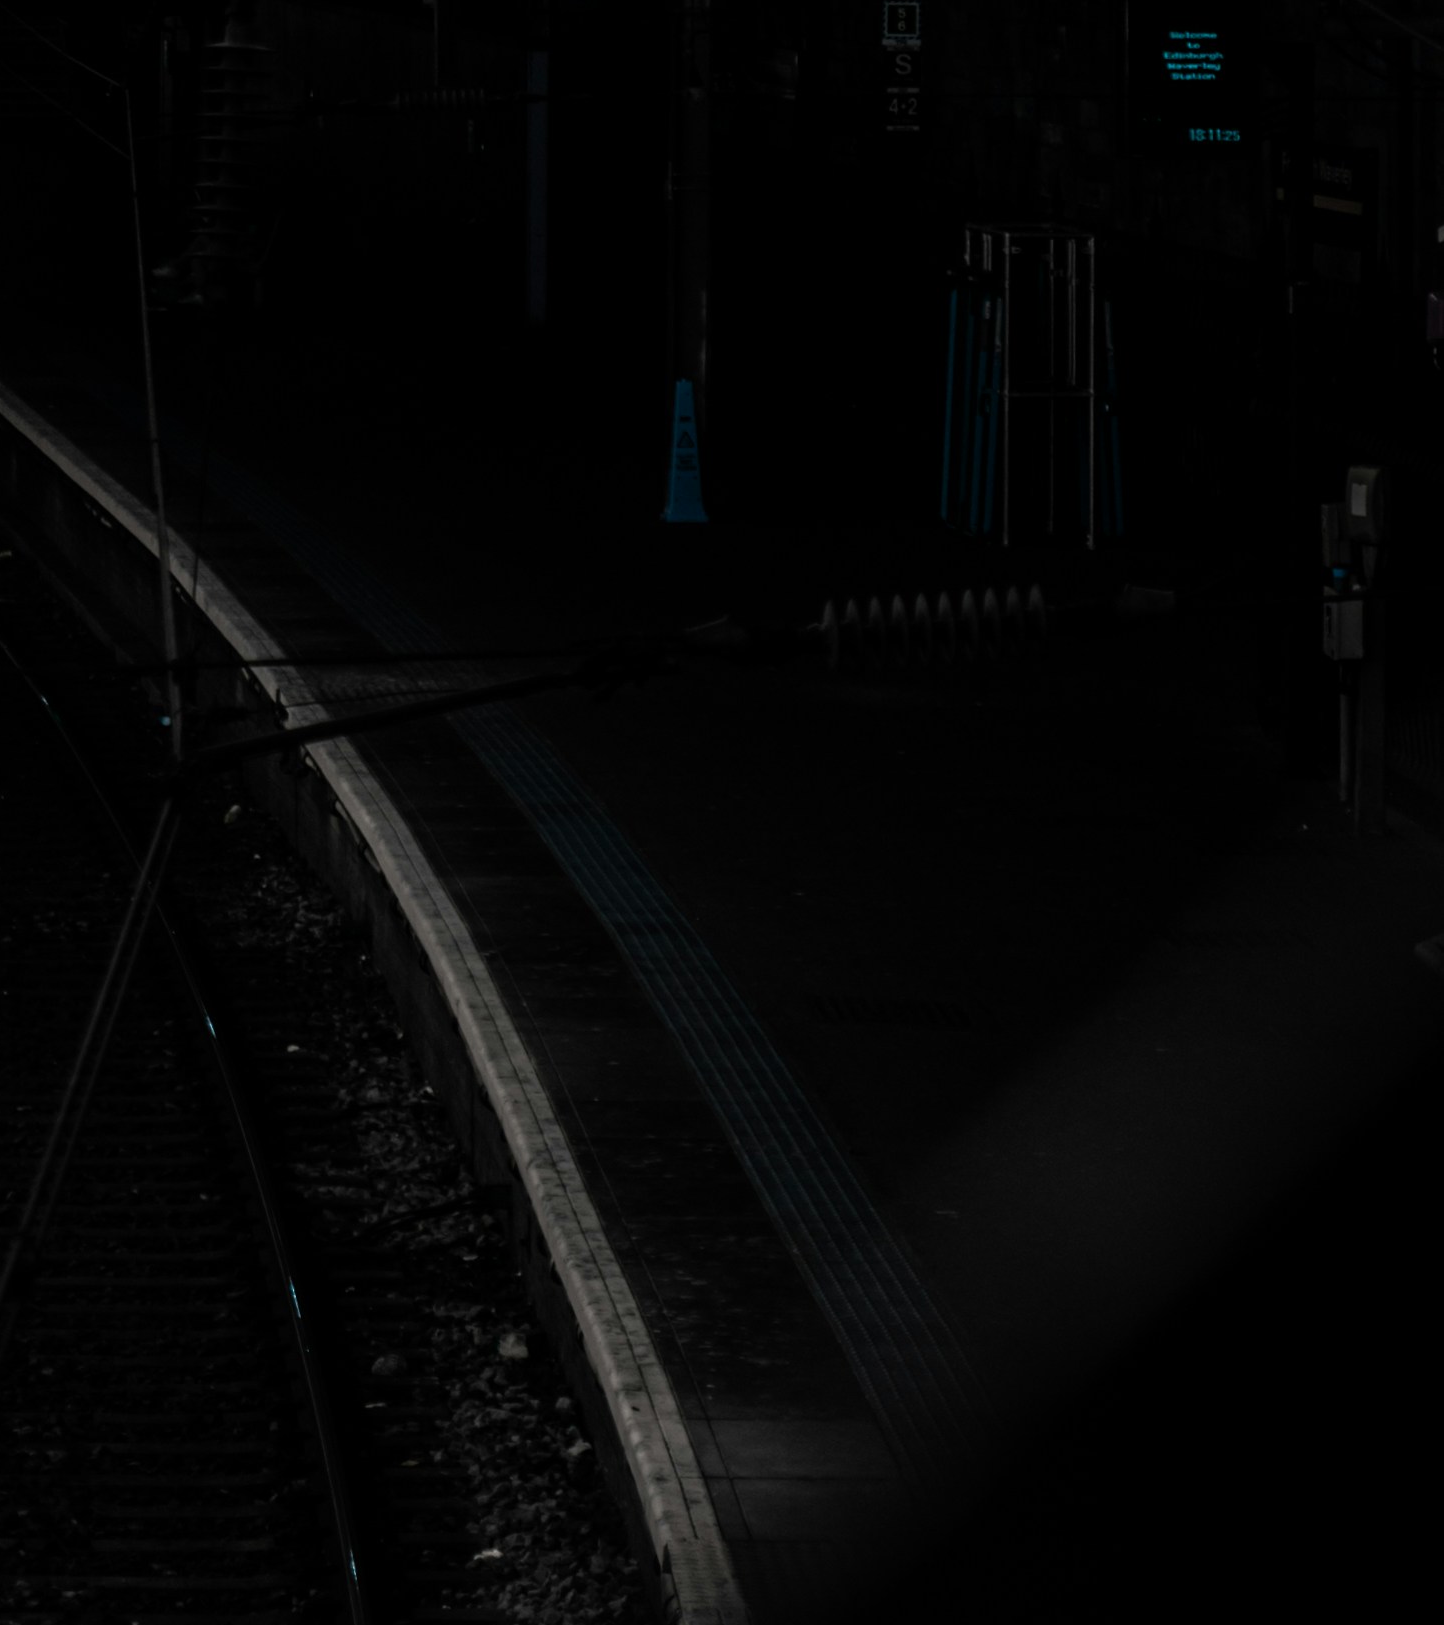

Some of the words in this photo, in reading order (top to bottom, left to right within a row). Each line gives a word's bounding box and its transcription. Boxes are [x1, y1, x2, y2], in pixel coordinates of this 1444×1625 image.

[897, 20, 907, 32] 6
[1168, 30, 1219, 40] Welcome
[1186, 41, 1201, 50] to
[1162, 50, 1225, 61] Edinburgh
[894, 52, 913, 76] S
[1166, 62, 1222, 72] Waverley
[1170, 72, 1217, 81] Station
